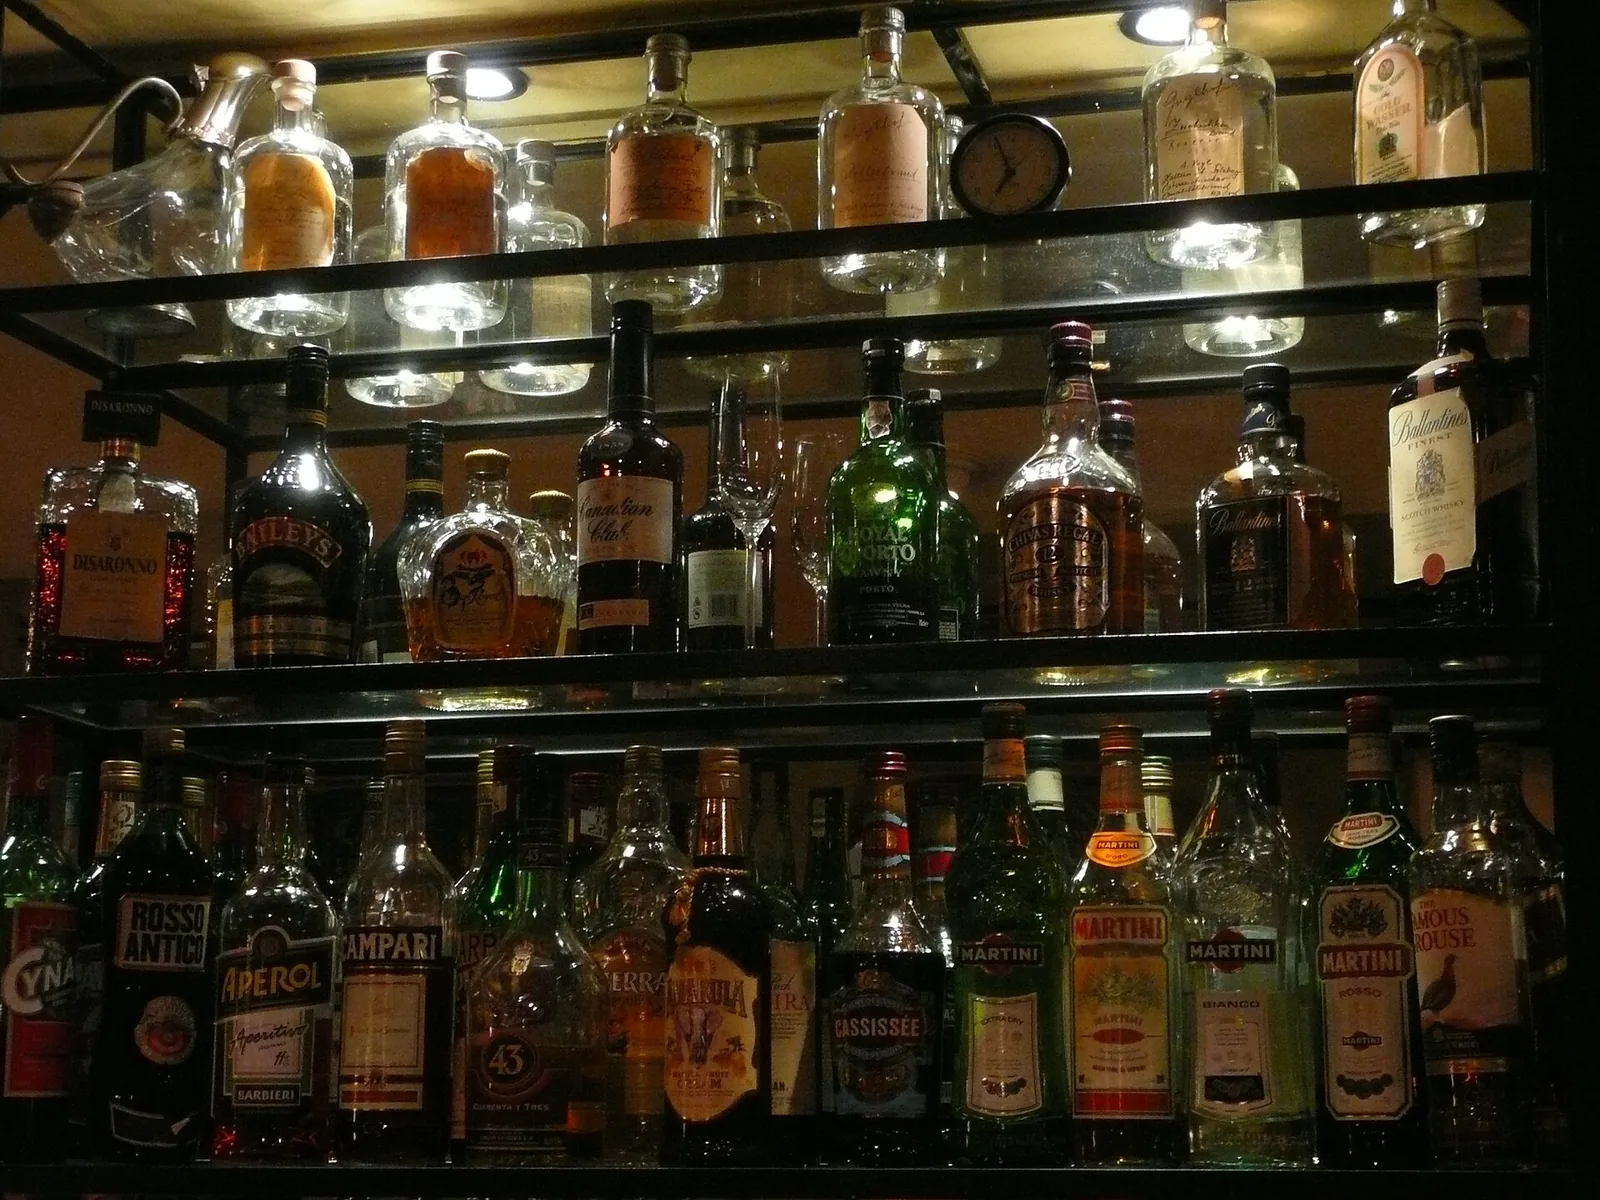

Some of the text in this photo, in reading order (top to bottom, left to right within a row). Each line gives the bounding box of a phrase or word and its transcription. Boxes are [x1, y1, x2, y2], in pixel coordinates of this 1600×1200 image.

[91, 400, 154, 415] DISARONNO
[1392, 407, 1469, 447] Ballantine's
[1407, 432, 1453, 450] FINEST
[1401, 500, 1465, 522] SCOTCH WHISKY
[588, 519, 634, 544] Club
[1008, 524, 1103, 552] CHIVAS REGAL
[1043, 546, 1057, 560] 12
[73, 554, 158, 575] DISARONNO
[860, 585, 895, 594] PORTO
[1344, 816, 1379, 829] MARTINI
[1098, 841, 1138, 849] MARTINI
[133, 902, 205, 932] ROSSO
[1076, 917, 1163, 941] MARTINI
[124, 934, 204, 964] ANTICO
[345, 933, 437, 961] AMPARI
[961, 948, 1039, 961] MARTINI
[1190, 944, 1271, 959] MARTINI
[1322, 949, 1402, 974] MARTINI
[3, 947, 75, 1015] CYNA
[221, 961, 323, 1004] APEROL
[1338, 987, 1383, 999] ROSSO
[1202, 1001, 1260, 1010] BIANCO
[835, 1014, 921, 1038] CASSISSÉE
[980, 1015, 1007, 1026] EXTRA
[1343, 1037, 1382, 1046] MARTINI
[488, 1044, 525, 1076] 43
[237, 1090, 295, 1102] BARBIERI
